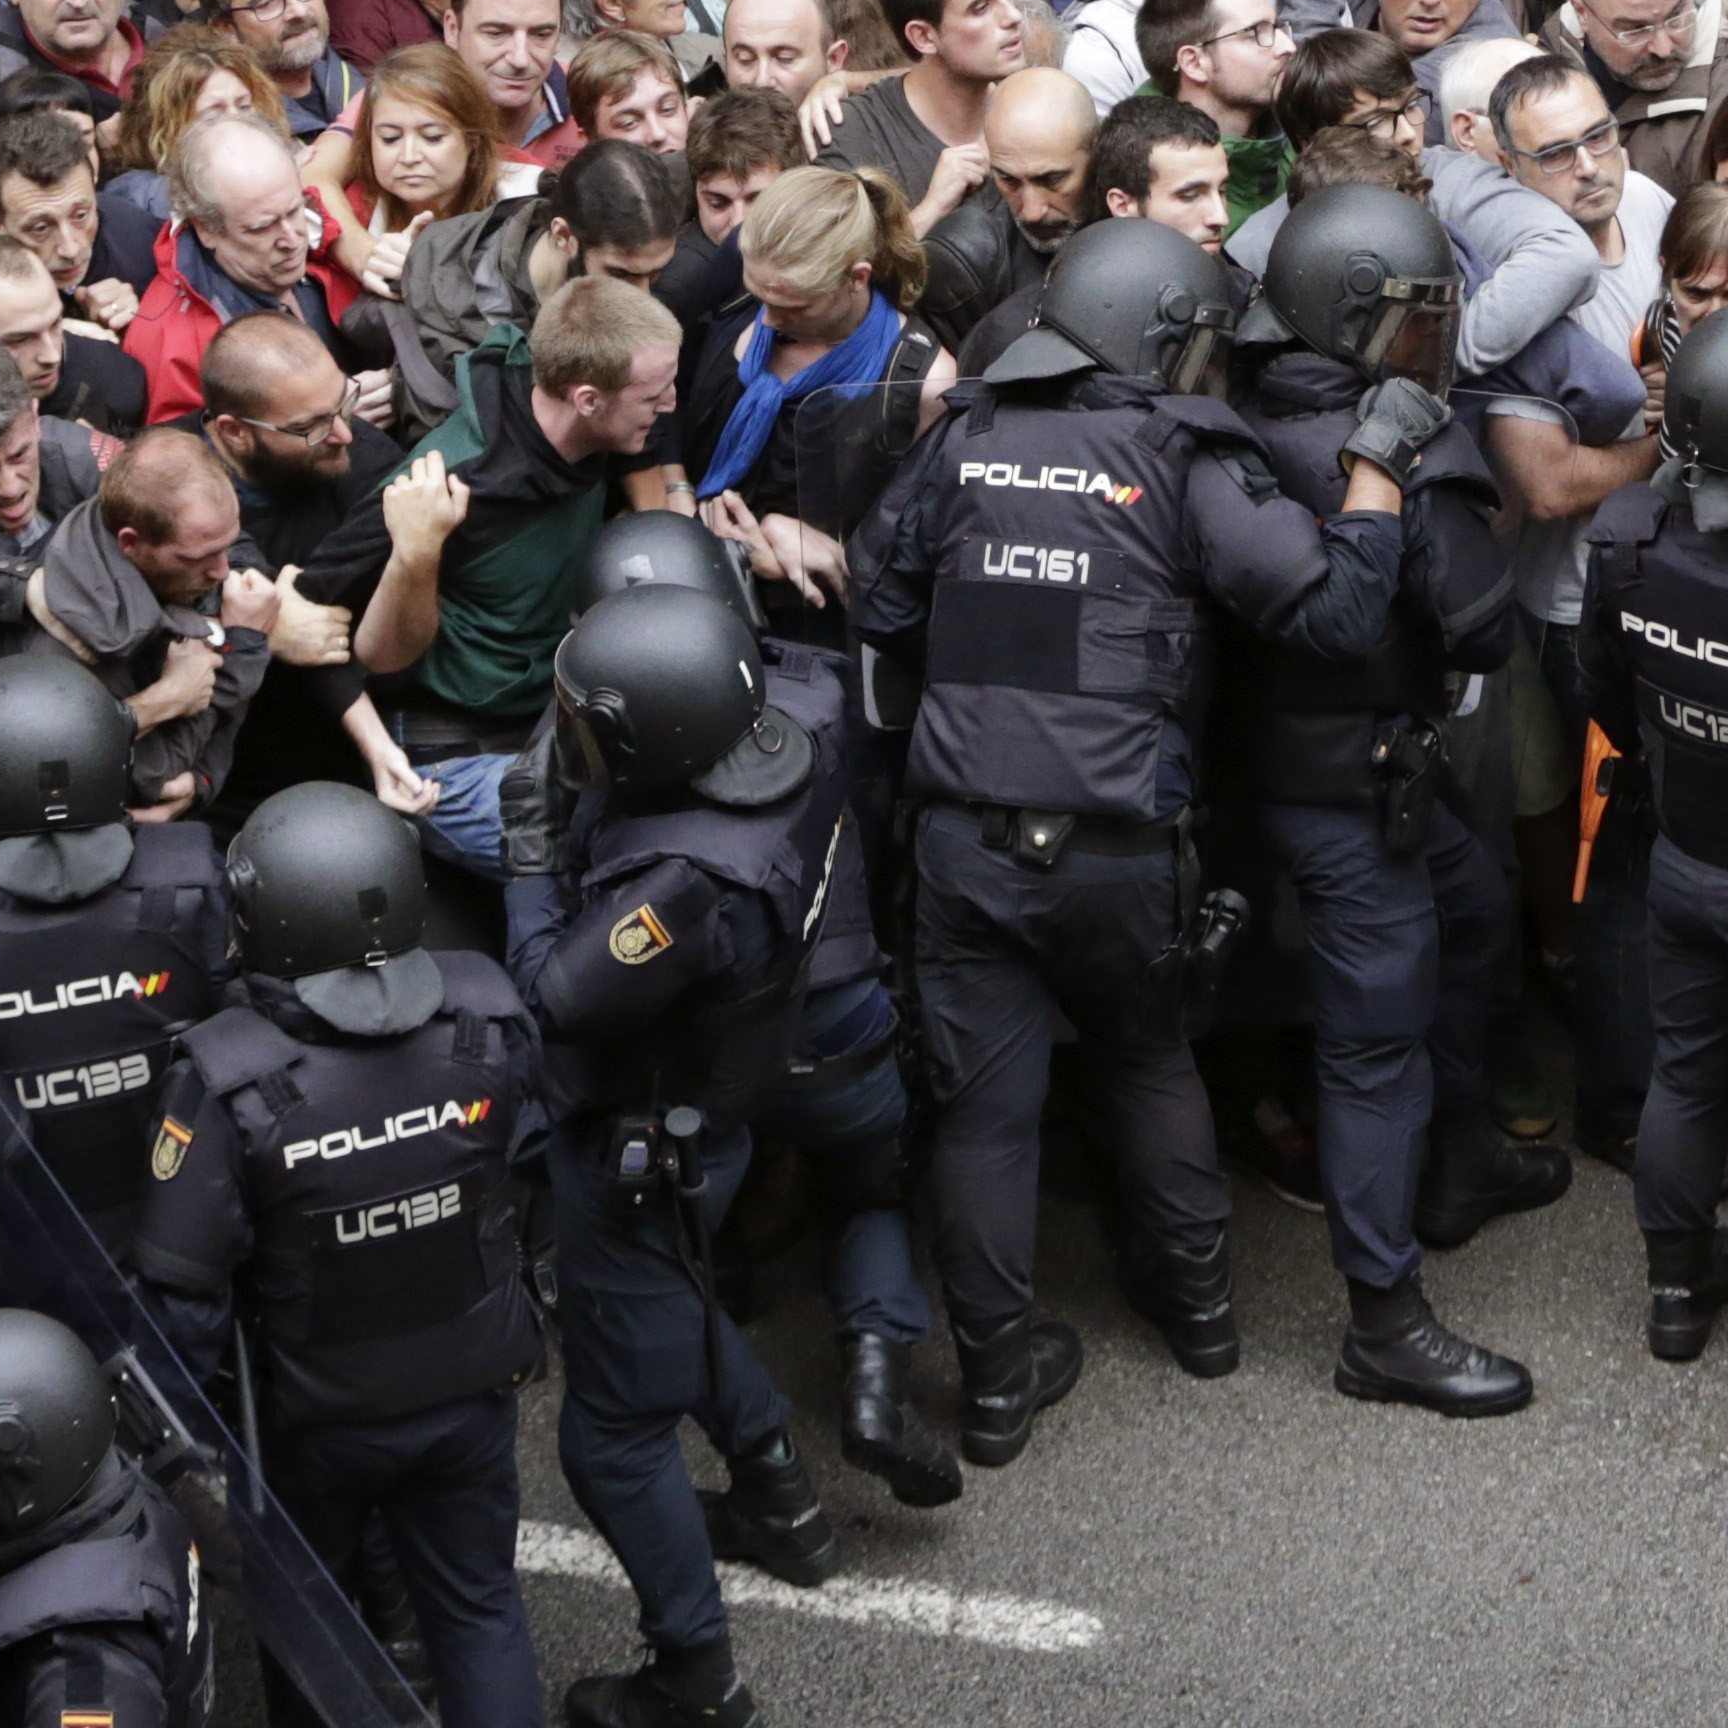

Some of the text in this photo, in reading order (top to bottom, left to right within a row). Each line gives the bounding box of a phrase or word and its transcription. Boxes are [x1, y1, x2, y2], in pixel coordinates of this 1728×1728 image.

[959, 461, 1115, 495] POLICIA
[983, 542, 1090, 585] UC161
[15, 1053, 151, 1109] UC133
[284, 1099, 466, 1169] POLICIA
[335, 1183, 462, 1244] UC132
